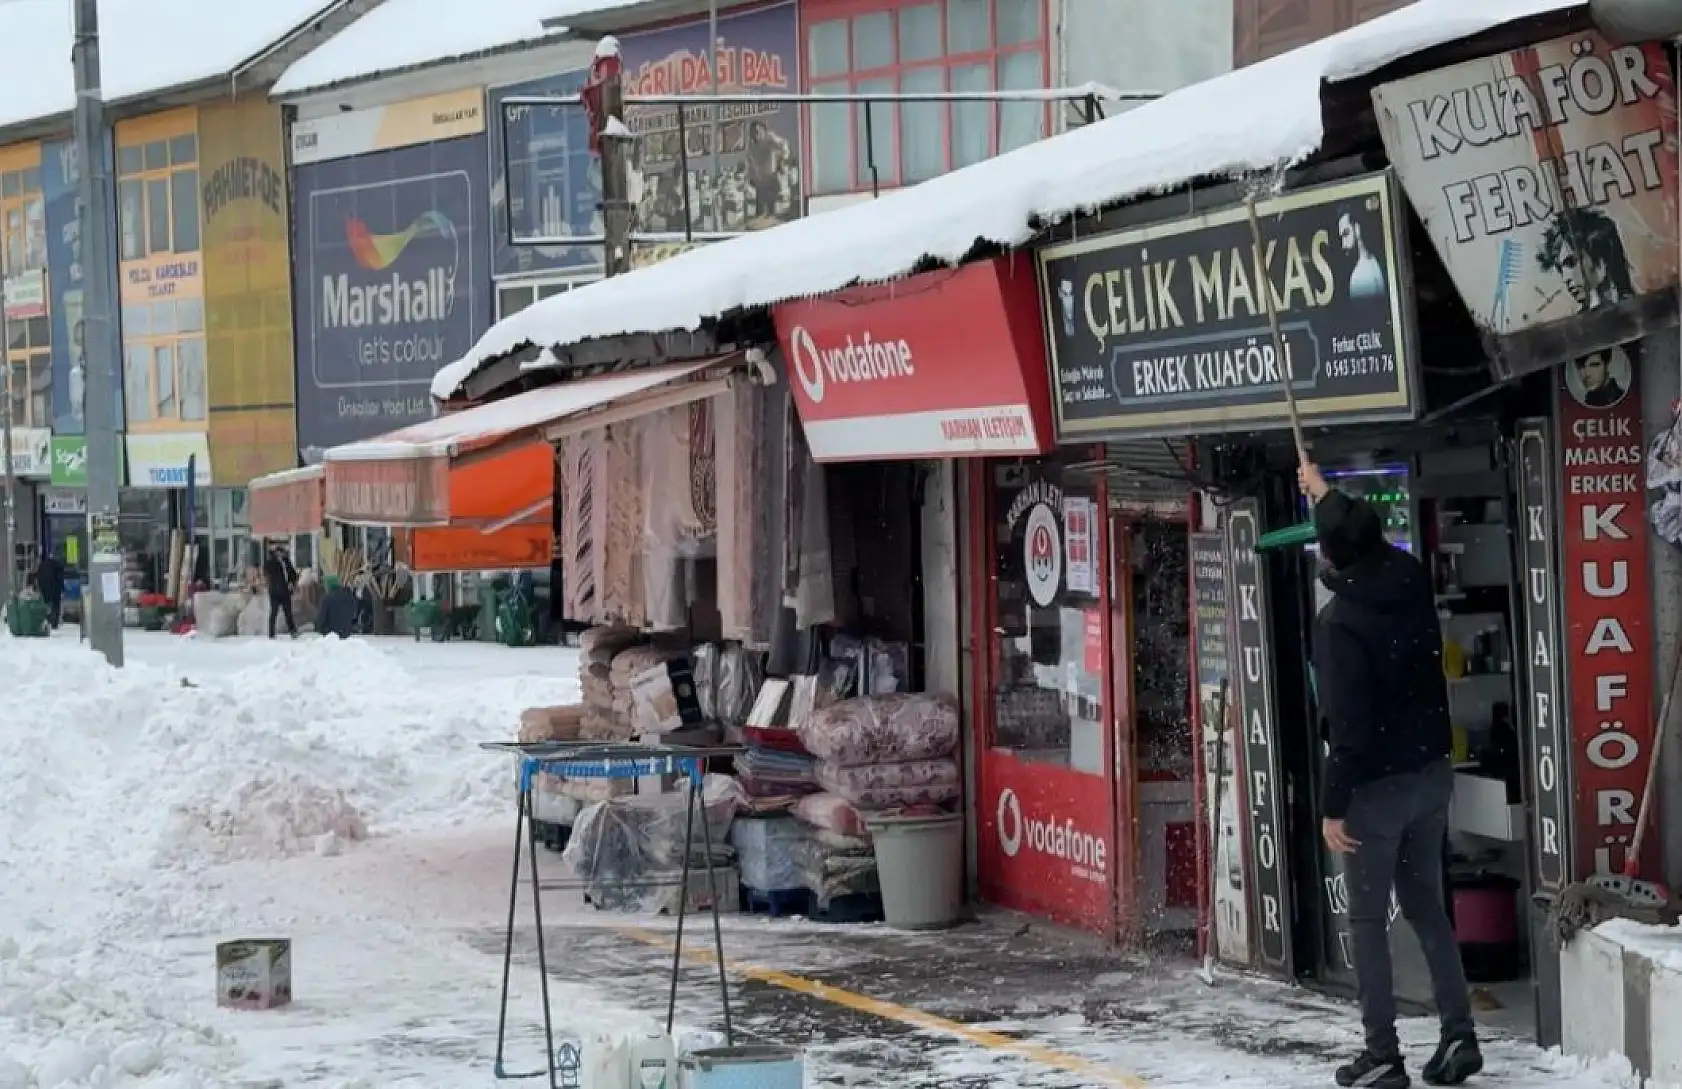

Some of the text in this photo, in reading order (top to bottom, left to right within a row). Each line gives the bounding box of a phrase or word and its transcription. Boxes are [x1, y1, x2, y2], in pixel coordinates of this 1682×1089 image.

[679, 38, 738, 91] DAĞI
[742, 48, 789, 88] BAL
[1407, 39, 1661, 160] KUAFÖR
[1442, 128, 1664, 243] FERHAT
[322, 265, 446, 329] Marshall
[1084, 229, 1335, 354] ÇELİK MAKAS
[358, 333, 444, 365] let's colour
[822, 331, 915, 384] vodafone
[1133, 355, 1192, 397] ERKEK
[1565, 445, 1641, 466] MAKAS
[1572, 413, 1631, 444] ÇELİK
[1570, 473, 1637, 494] ERKEK
[1528, 505, 1559, 855] KUAFÖR
[1238, 584, 1280, 933] KUAFÖR
[1023, 815, 1107, 870] vodafone
